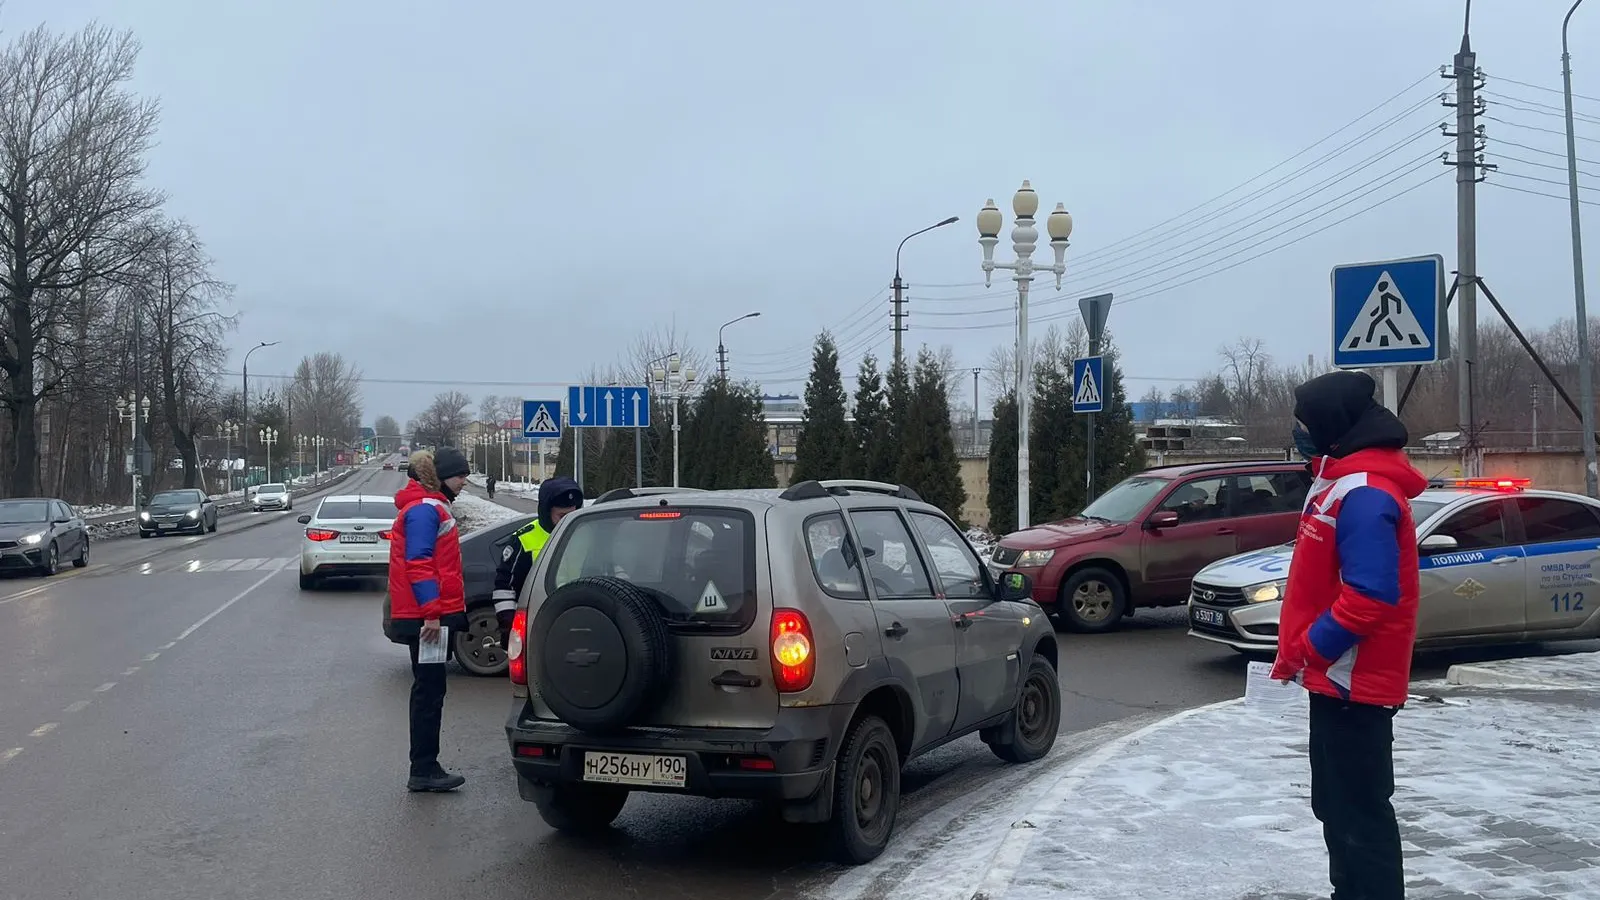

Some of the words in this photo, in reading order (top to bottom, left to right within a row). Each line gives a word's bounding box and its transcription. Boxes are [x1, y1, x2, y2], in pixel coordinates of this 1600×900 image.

[1431, 552, 1485, 566] ПОЛИЦИЯ
[1540, 563, 1564, 572] ОМВД
[1565, 563, 1591, 571] России
[705, 595, 717, 607] Ш
[1550, 591, 1584, 613] 112
[712, 649, 755, 659] NIVA
[589, 755, 652, 778] Н256НУ
[655, 757, 681, 774] 190
